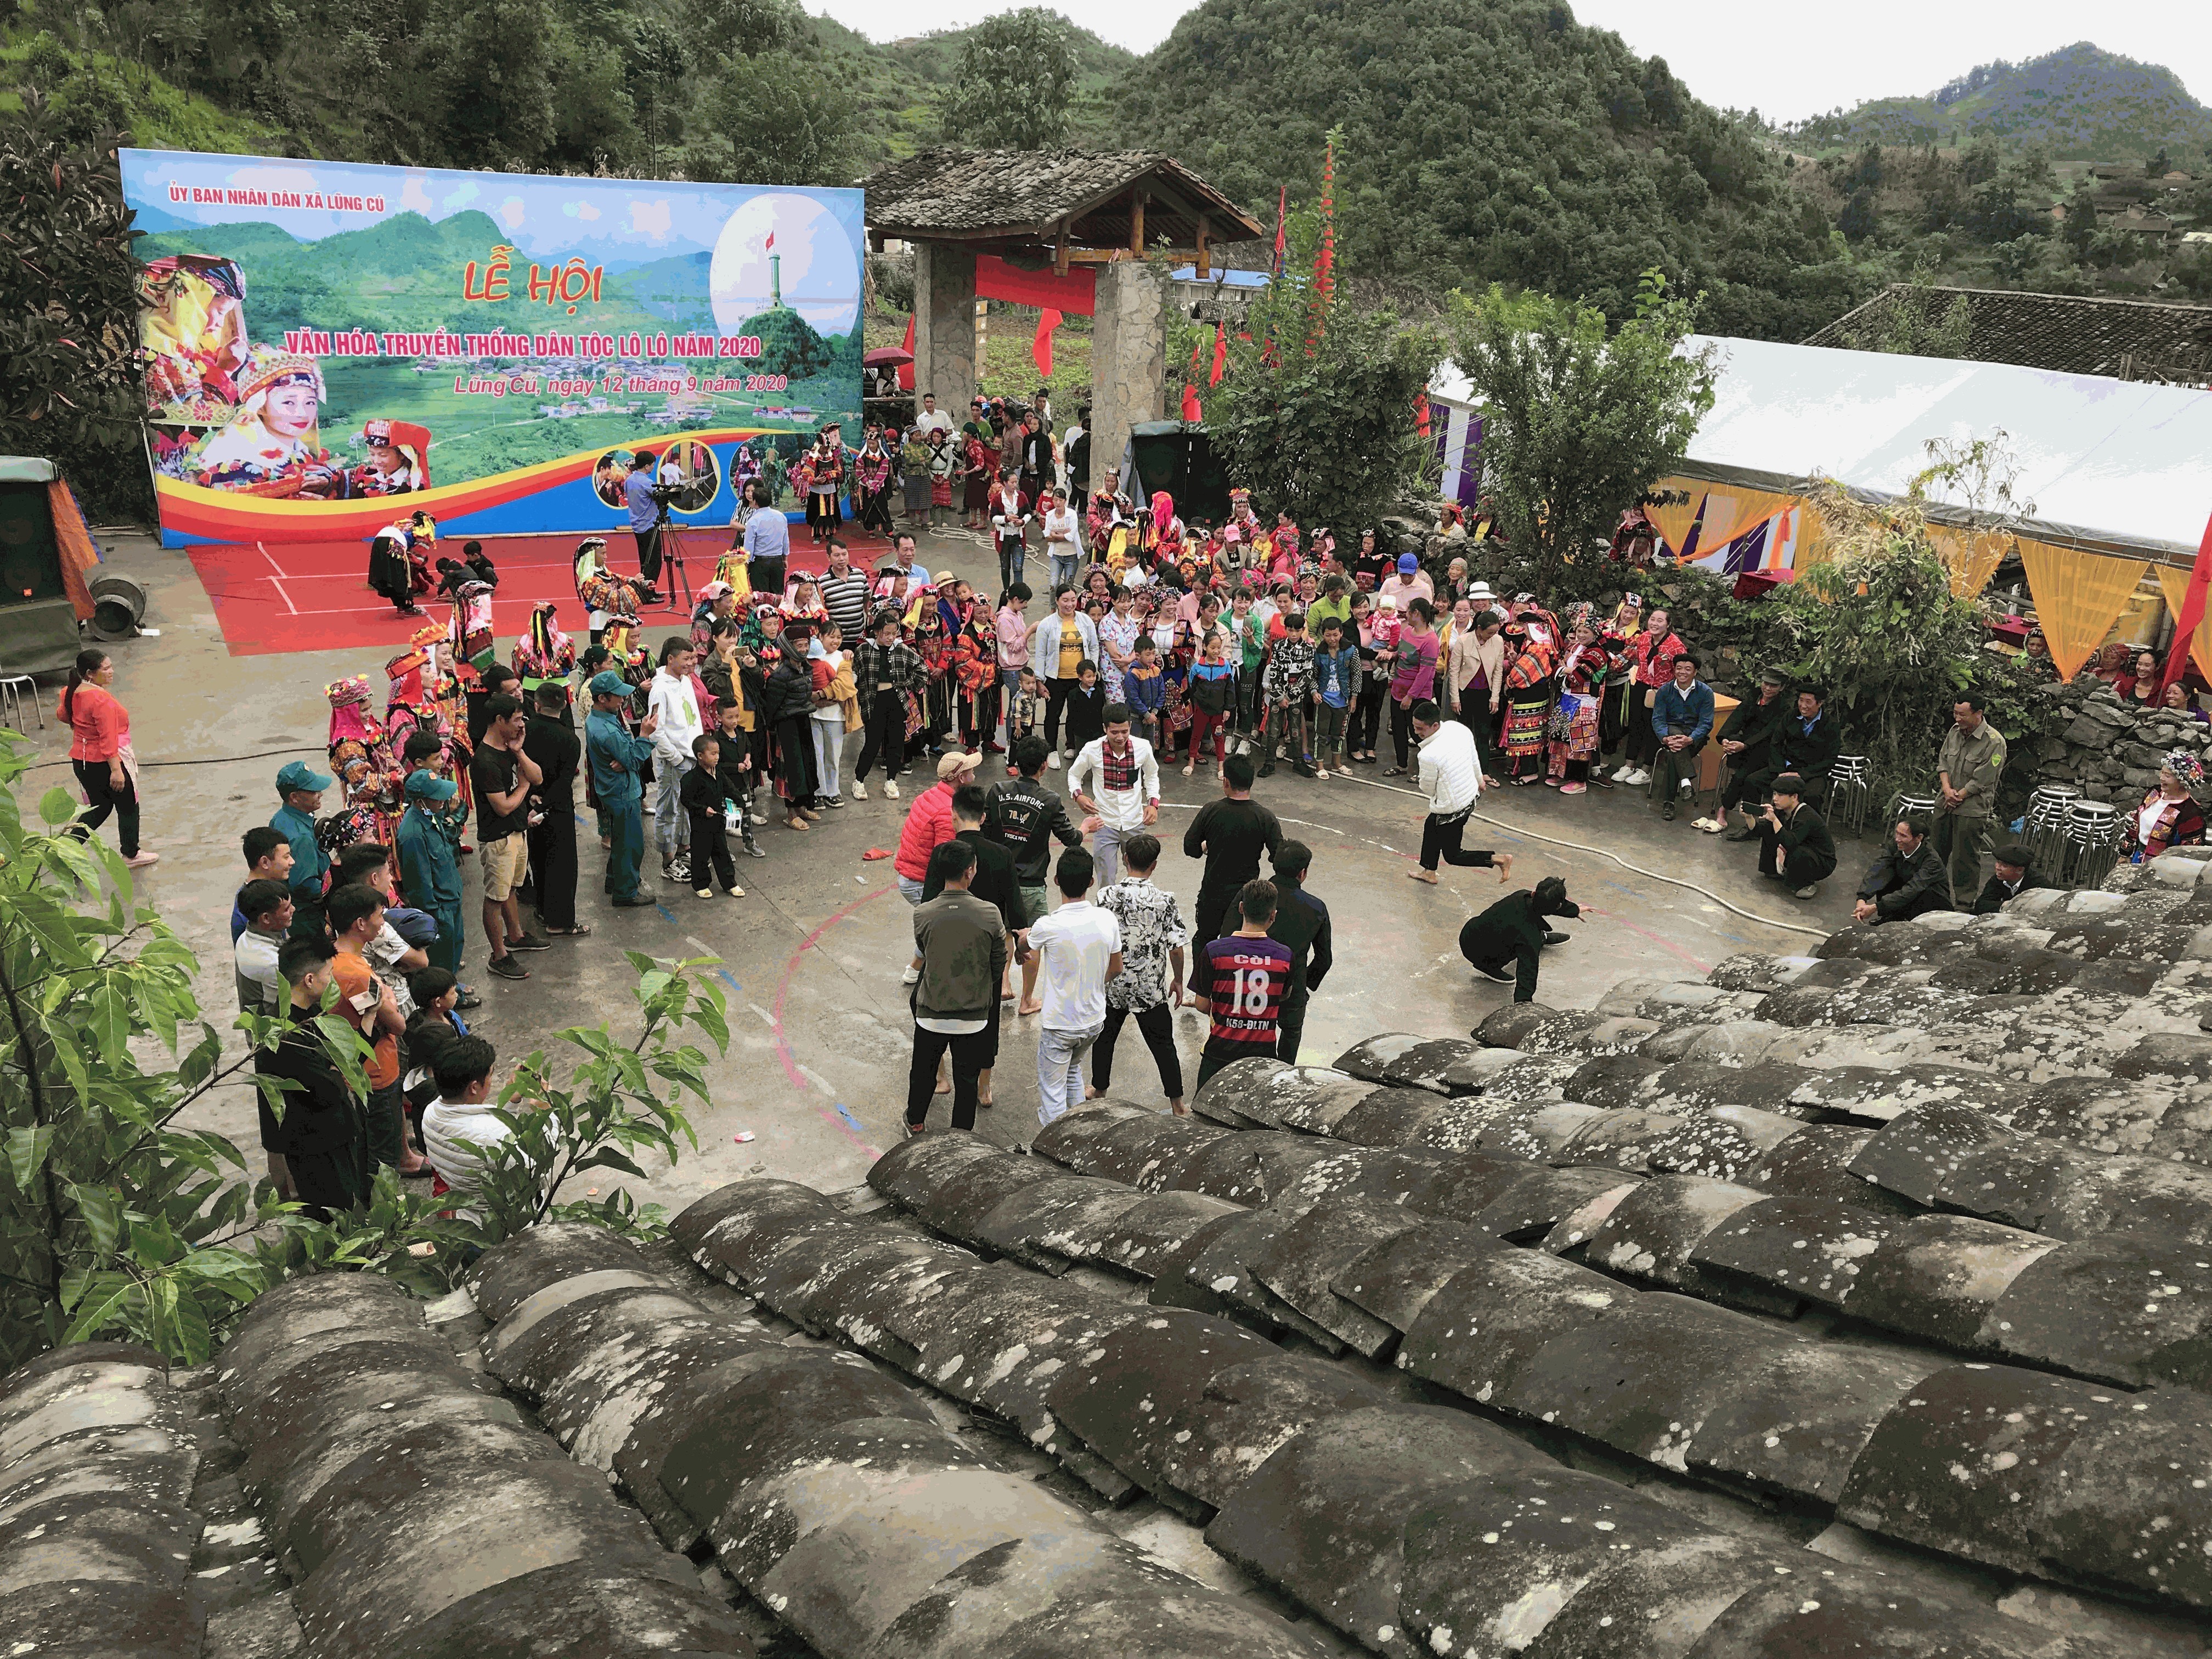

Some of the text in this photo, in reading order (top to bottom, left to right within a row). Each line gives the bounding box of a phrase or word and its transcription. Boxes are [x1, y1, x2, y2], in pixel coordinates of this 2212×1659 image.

[169, 180, 384, 212] ỦY BAN NHÂN DÂN XÃ LŨNG CÚ
[465, 245, 603, 315] LỄ HỘI
[285, 326, 760, 360] VĂN HÓA TRUYỀN THỐNG DÂN TỘC LÔ LÔ NĂM 2020
[454, 375, 787, 397] Lũng Cú, ngày 12 tháng 9 năm 2020
[998, 793, 1013, 802] U.S.
[1234, 954, 1271, 965] Còi
[1231, 967, 1270, 1015] 18
[1226, 1018, 1269, 1030] K58-ĐLTN
